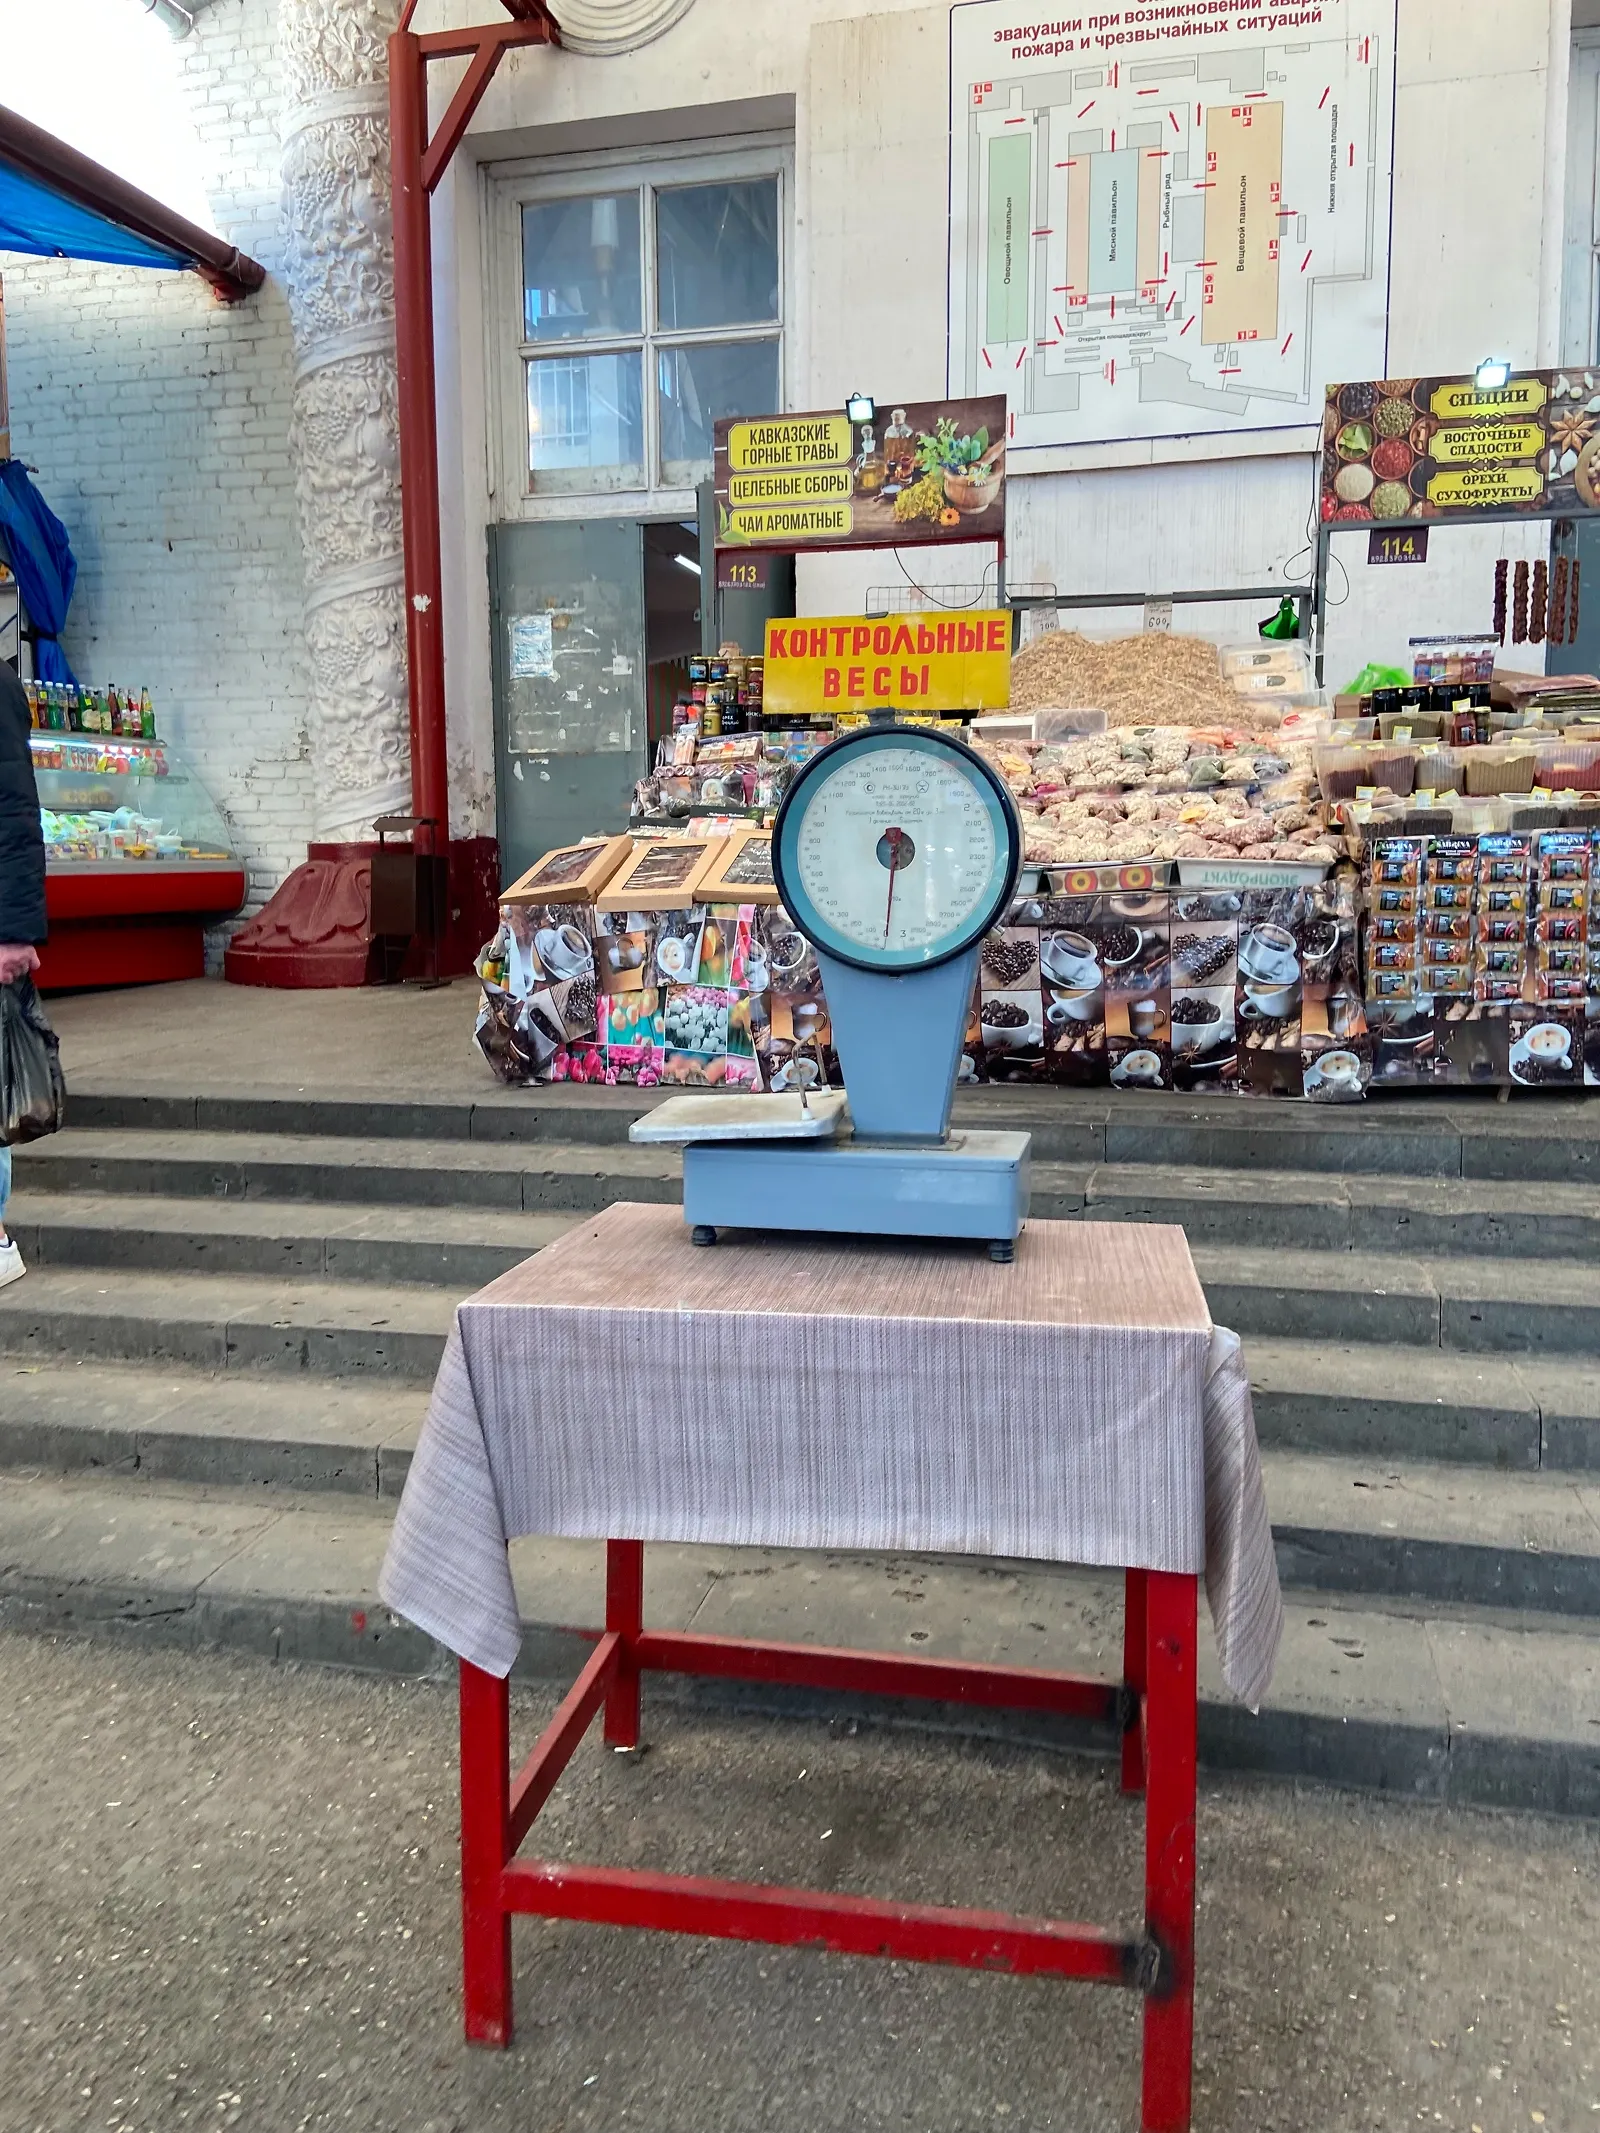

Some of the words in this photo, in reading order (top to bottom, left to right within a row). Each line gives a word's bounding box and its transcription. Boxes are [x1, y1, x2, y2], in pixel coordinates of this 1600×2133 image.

[993, 19, 1082, 43] эвакуации
[1088, 13, 1120, 32] при
[1124, 0, 1262, 24] возникновении
[1011, 39, 1074, 60] пожара
[1080, 36, 1091, 50] и
[1095, 19, 1229, 50] чрезвычайных
[1236, 5, 1323, 32] ситуаций
[1329, 144, 1337, 182] открытая
[1162, 191, 1171, 229] Рыбный
[1239, 174, 1247, 224] павильон
[1327, 182, 1336, 214] Нижняя
[1109, 226, 1117, 262] Мясной
[1236, 225, 1246, 272] Вещевой
[1448, 388, 1530, 407] СПЕЦИИ
[749, 423, 832, 446] КАВКАЗСКИЕ
[1443, 428, 1531, 444] ВОСТОЧНЫЕ
[742, 446, 793, 466] ГОРНЫЕ
[795, 442, 839, 462] ТРАВЫ
[1449, 442, 1523, 457] СЛАДОСТИ
[733, 477, 802, 499] ЦЕЛЕБНЫЕ
[804, 473, 849, 494] СБОРЫ
[1461, 473, 1508, 486] ОРЕХИ
[1435, 486, 1534, 502] СУХОФРУКТЫ
[766, 510, 844, 532] АРОМАТНЫЕ
[1381, 536, 1415, 557] 114
[729, 564, 758, 583] 113
[769, 620, 1006, 659] КОНТРОЛЬНЫЕ
[823, 665, 930, 698] ВЕСЫ
[963, 803, 971, 812] 2
[900, 929, 907, 938] 3
